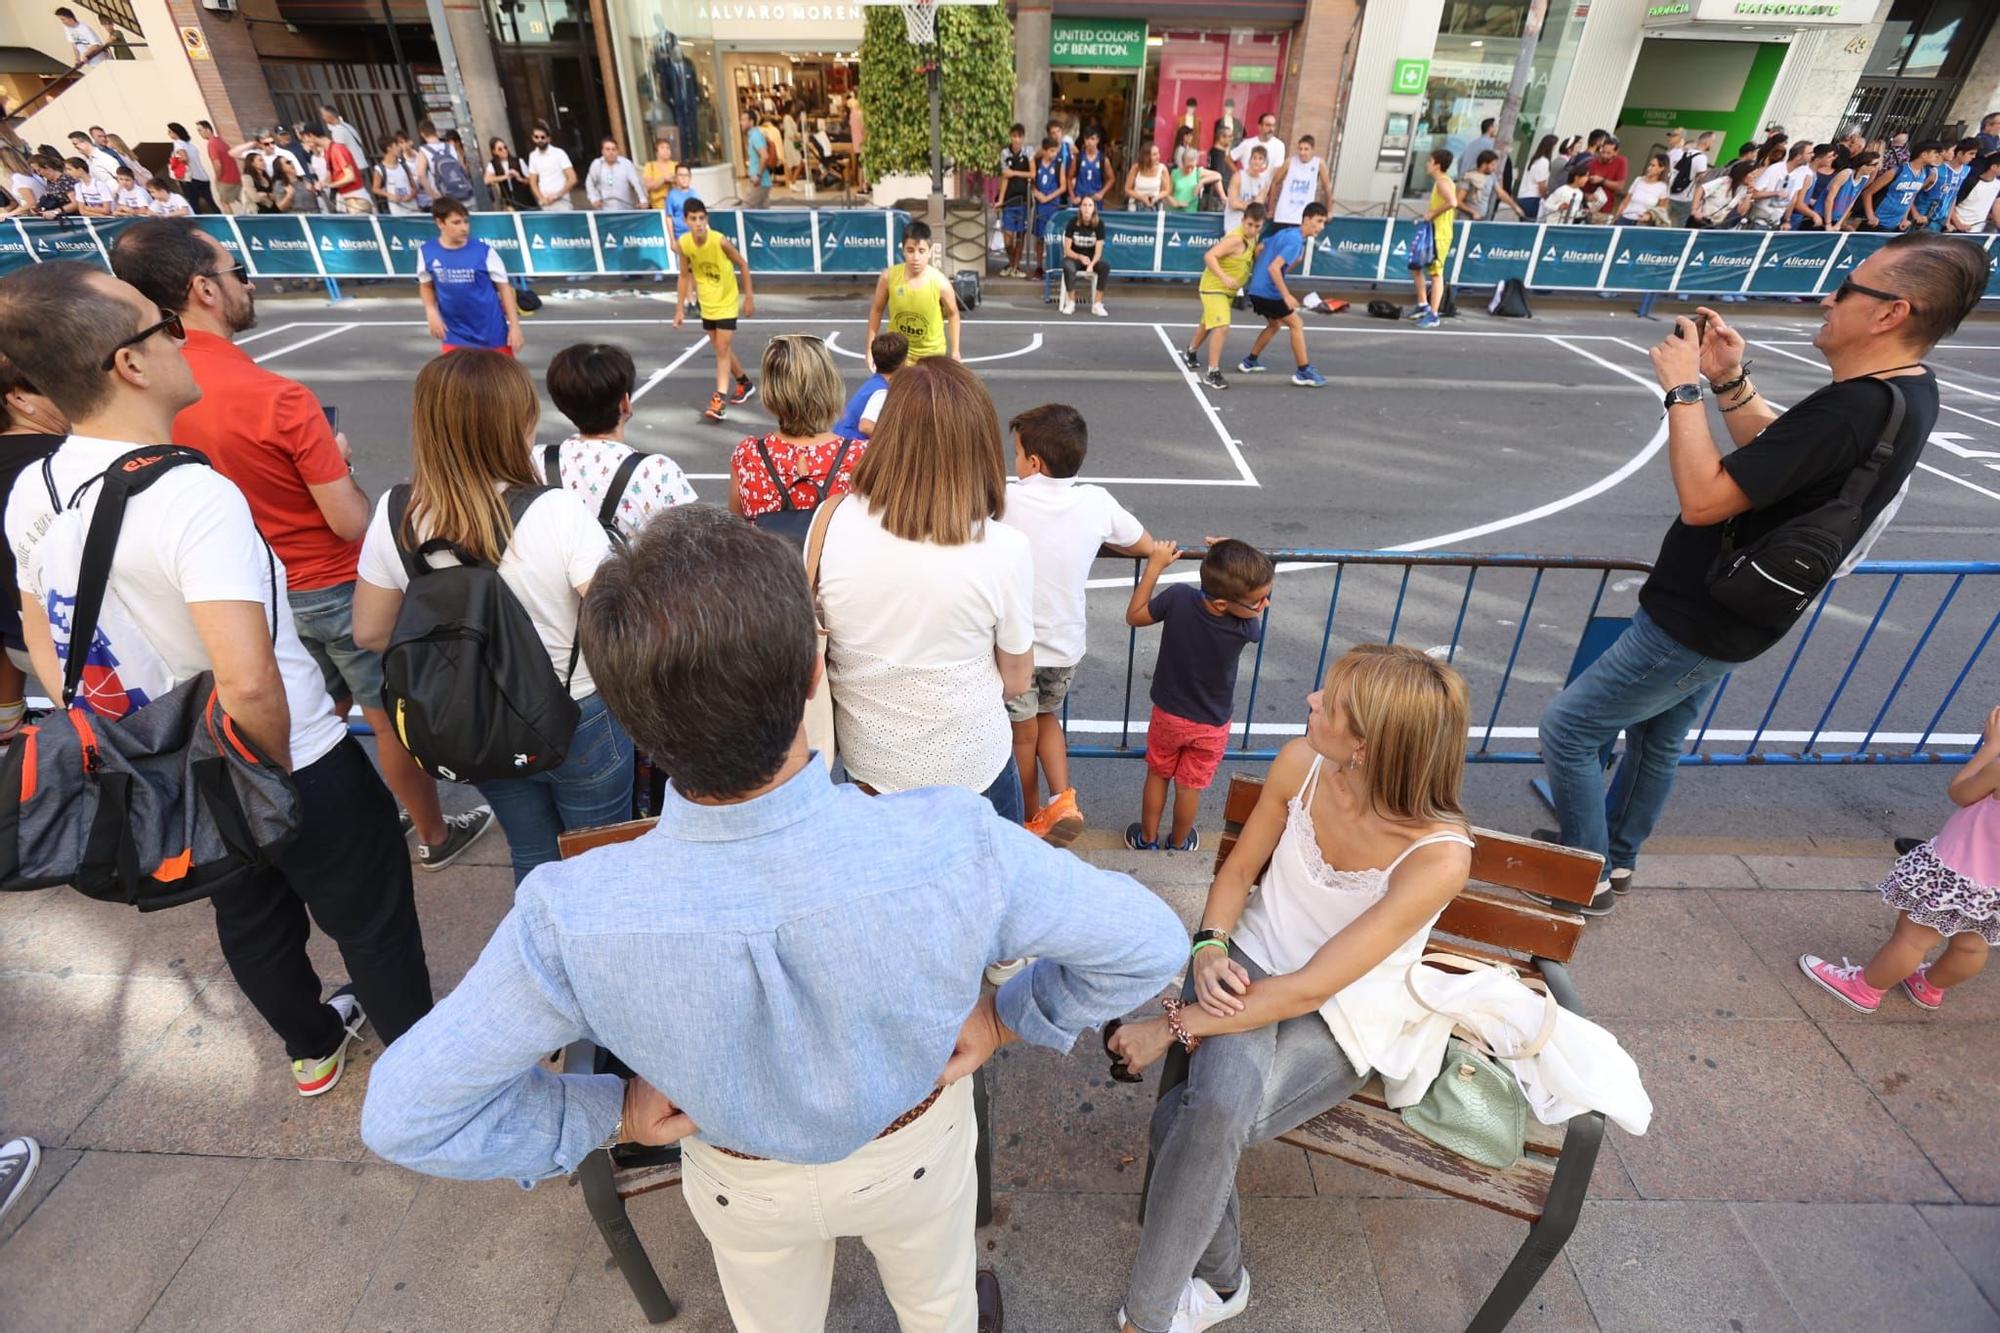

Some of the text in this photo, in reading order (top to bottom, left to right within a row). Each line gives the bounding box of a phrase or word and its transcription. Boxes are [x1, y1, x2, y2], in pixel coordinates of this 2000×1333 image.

[711, 5, 870, 20] ALVARO MOREN
[1648, 3, 1689, 16] FARMACIA
[1054, 30, 1140, 43] UNITED COLORS
[1054, 43, 1069, 55] OF
[1900, 191, 1914, 205] 12
[268, 238, 308, 250] Alicante
[338, 238, 379, 250] Alicante
[550, 236, 592, 248] Alicante
[623, 235, 665, 247] Alicante
[769, 235, 812, 246] Alicante
[844, 235, 886, 246] Alicante
[1112, 233, 1155, 243] Alicante
[55, 240, 97, 251] Alicante
[1338, 240, 1381, 251] Alicante
[1488, 247, 1531, 259] Alicante
[1562, 250, 1605, 262] Alicante
[1636, 253, 1679, 264] Alicante
[1709, 255, 1752, 265] Alicante
[1783, 256, 1827, 267] Alicante
[900, 324, 924, 336] cbc
[26, 531, 38, 545] A
